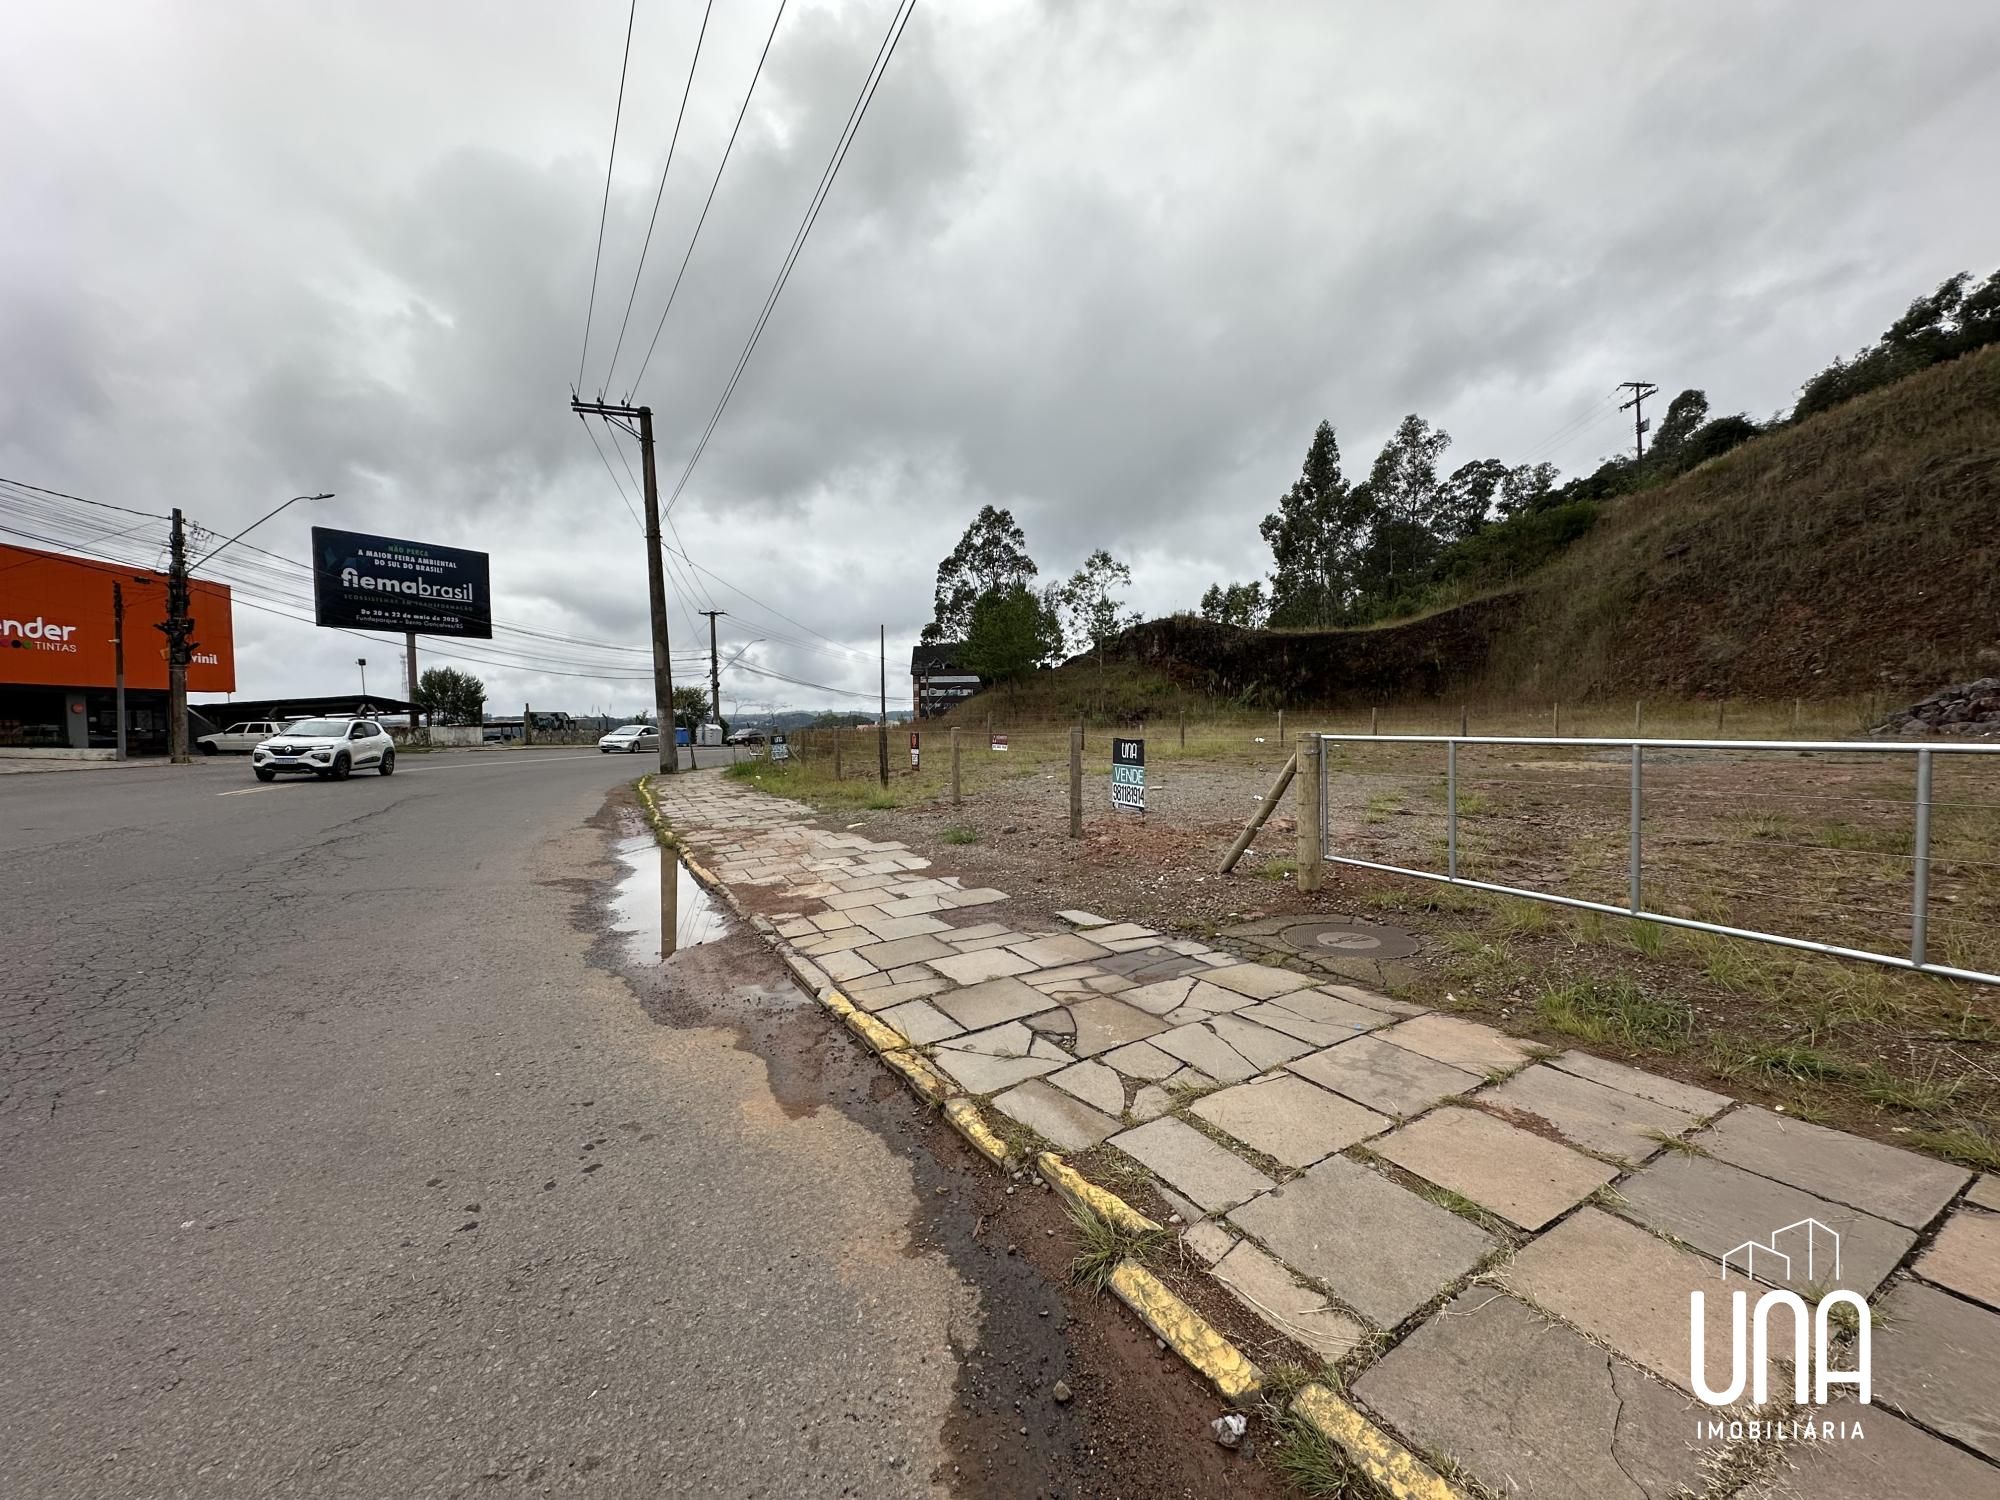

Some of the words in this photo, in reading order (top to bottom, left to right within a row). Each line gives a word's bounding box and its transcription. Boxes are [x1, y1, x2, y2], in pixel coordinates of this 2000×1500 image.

[365, 550, 392, 560] MAIOR
[394, 554, 416, 563] FEIRA
[417, 557, 457, 569] AMBIENTAL
[387, 560, 401, 568] SUL
[403, 562, 414, 570] DO
[415, 564, 444, 574] BRASIL!
[341, 567, 473, 600] fiemabrasil
[0, 616, 77, 641] nder
[34, 641, 77, 653] TINTAS
[191, 652, 218, 665] vinil
[1121, 742, 1138, 760] UNA
[1114, 766, 1144, 785] VENDE
[1113, 784, 1145, 806] 981181914
